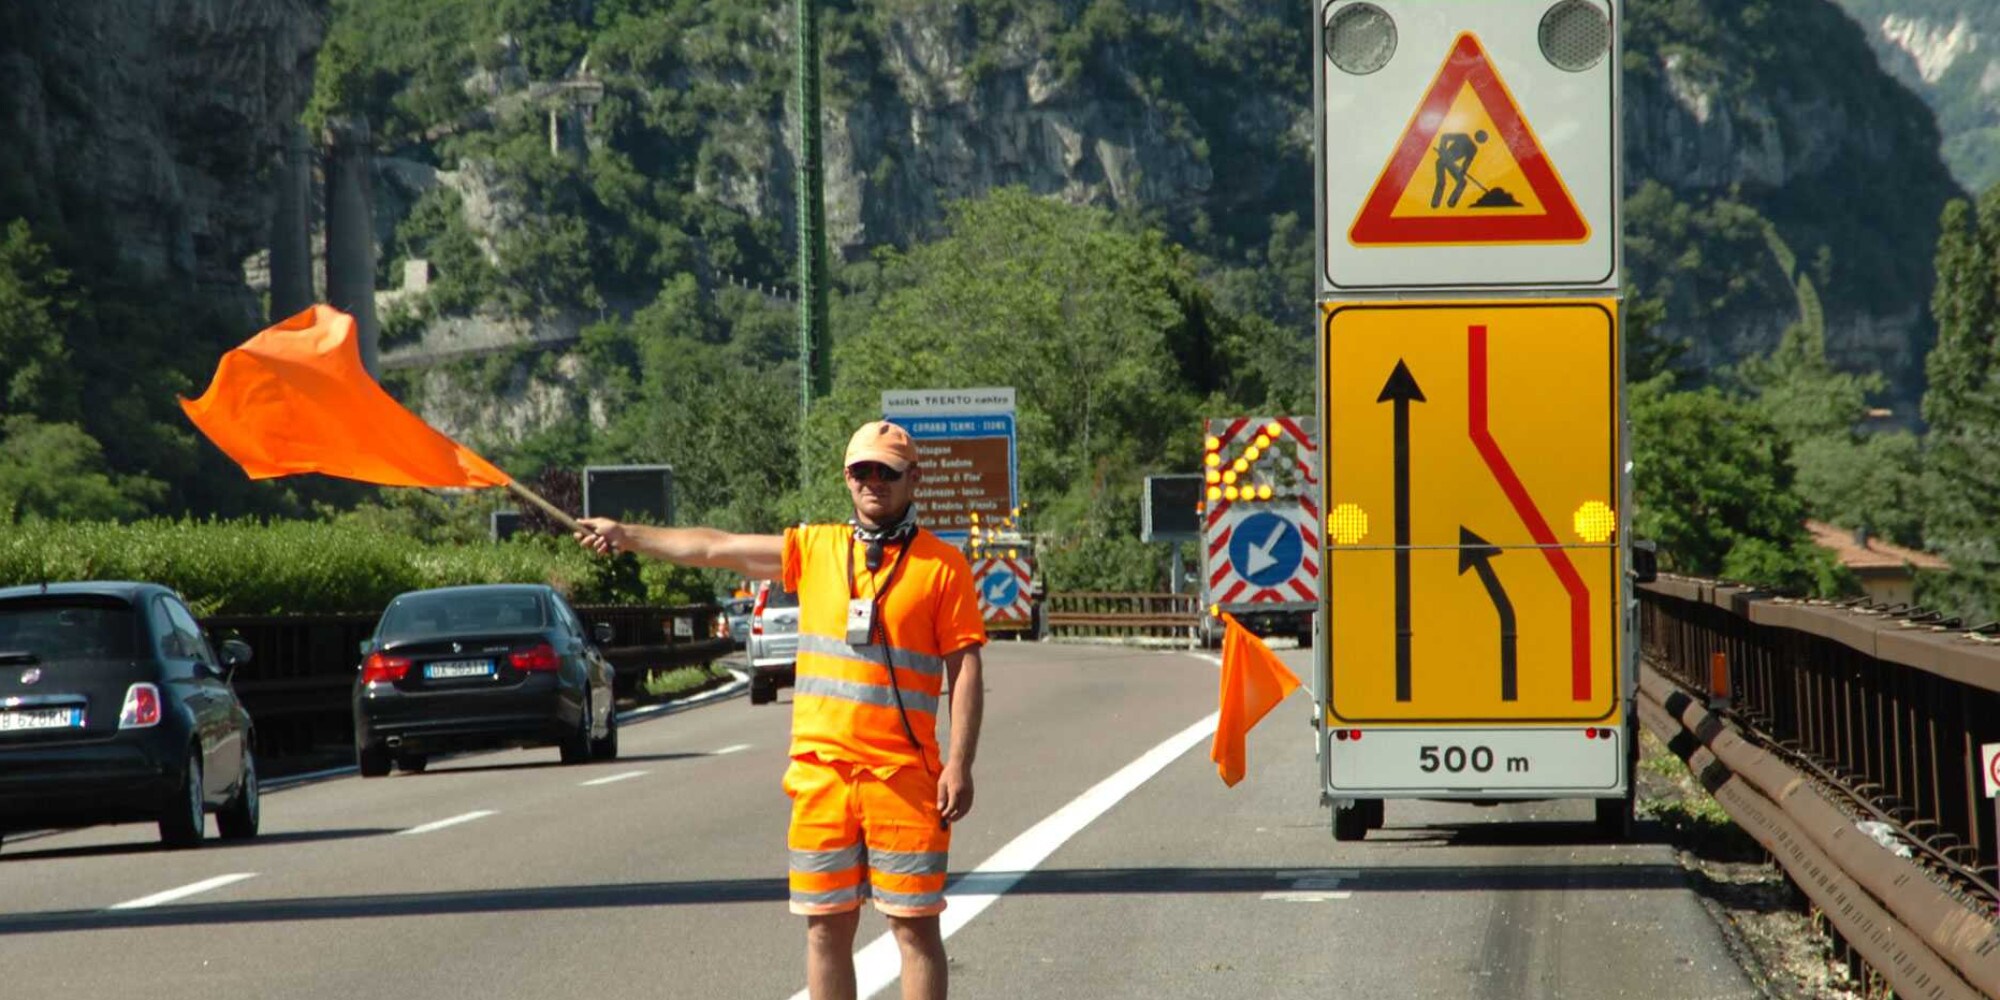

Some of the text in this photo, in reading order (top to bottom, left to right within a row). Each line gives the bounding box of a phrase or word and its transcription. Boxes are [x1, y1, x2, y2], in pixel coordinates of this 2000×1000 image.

[888, 395, 1009, 406] uscita TRENTO centro
[913, 421, 947, 432] COMANO
[949, 421, 975, 431] TERME
[1419, 745, 1529, 773] 500 m
